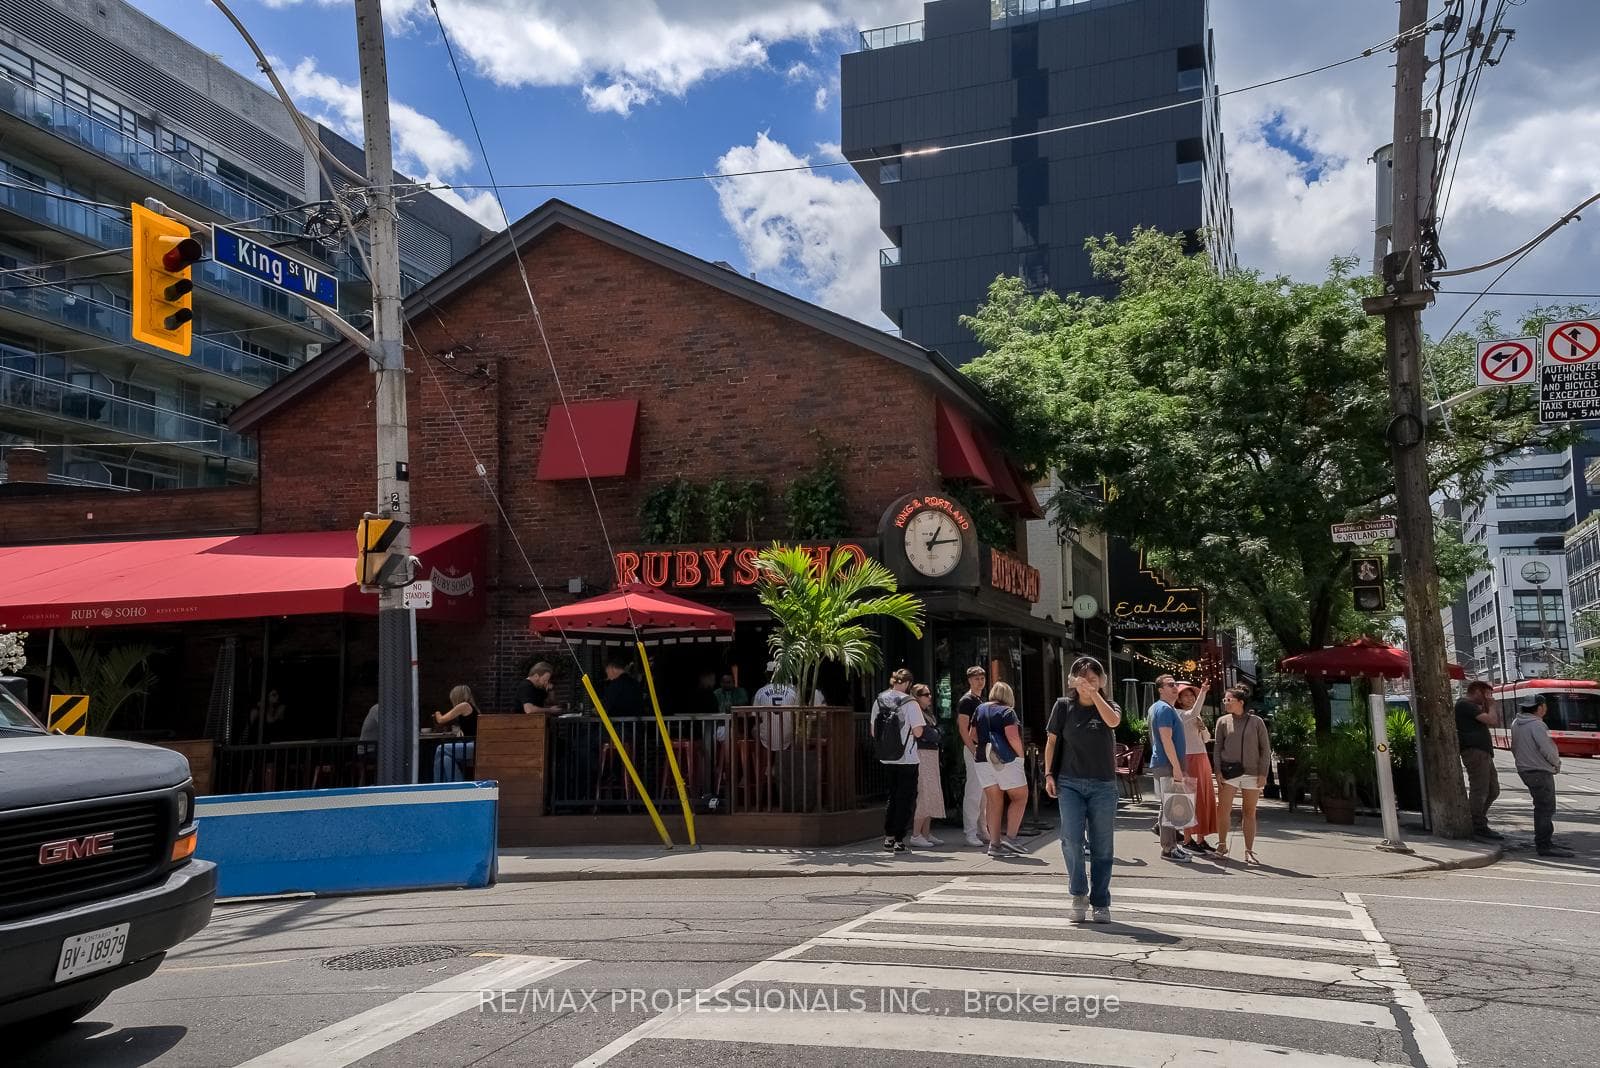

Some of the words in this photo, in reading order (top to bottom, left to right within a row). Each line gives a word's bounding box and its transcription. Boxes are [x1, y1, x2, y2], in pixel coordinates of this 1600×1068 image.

[238, 239, 282, 284] King
[289, 262, 299, 276] St
[304, 267, 318, 293] W
[1551, 371, 1597, 382] VEHICLES
[1543, 383, 1560, 391] AND
[1565, 380, 1600, 390] BICYCLE
[1550, 389, 1597, 399] EXCEPTED
[1542, 402, 1563, 410] TAXIS
[1567, 399, 1600, 409] EXCEPTE
[895, 504, 914, 528] KING
[912, 499, 923, 508] &
[924, 496, 969, 530] PORTLAND
[1365, 522, 1391, 530] District
[1380, 530, 1389, 538] ST
[413, 583, 422, 591] NO
[1114, 595, 1197, 617] Earls
[71, 608, 100, 620] RUBY
[115, 606, 147, 618] SOHO
[39, 832, 115, 865] GMC
